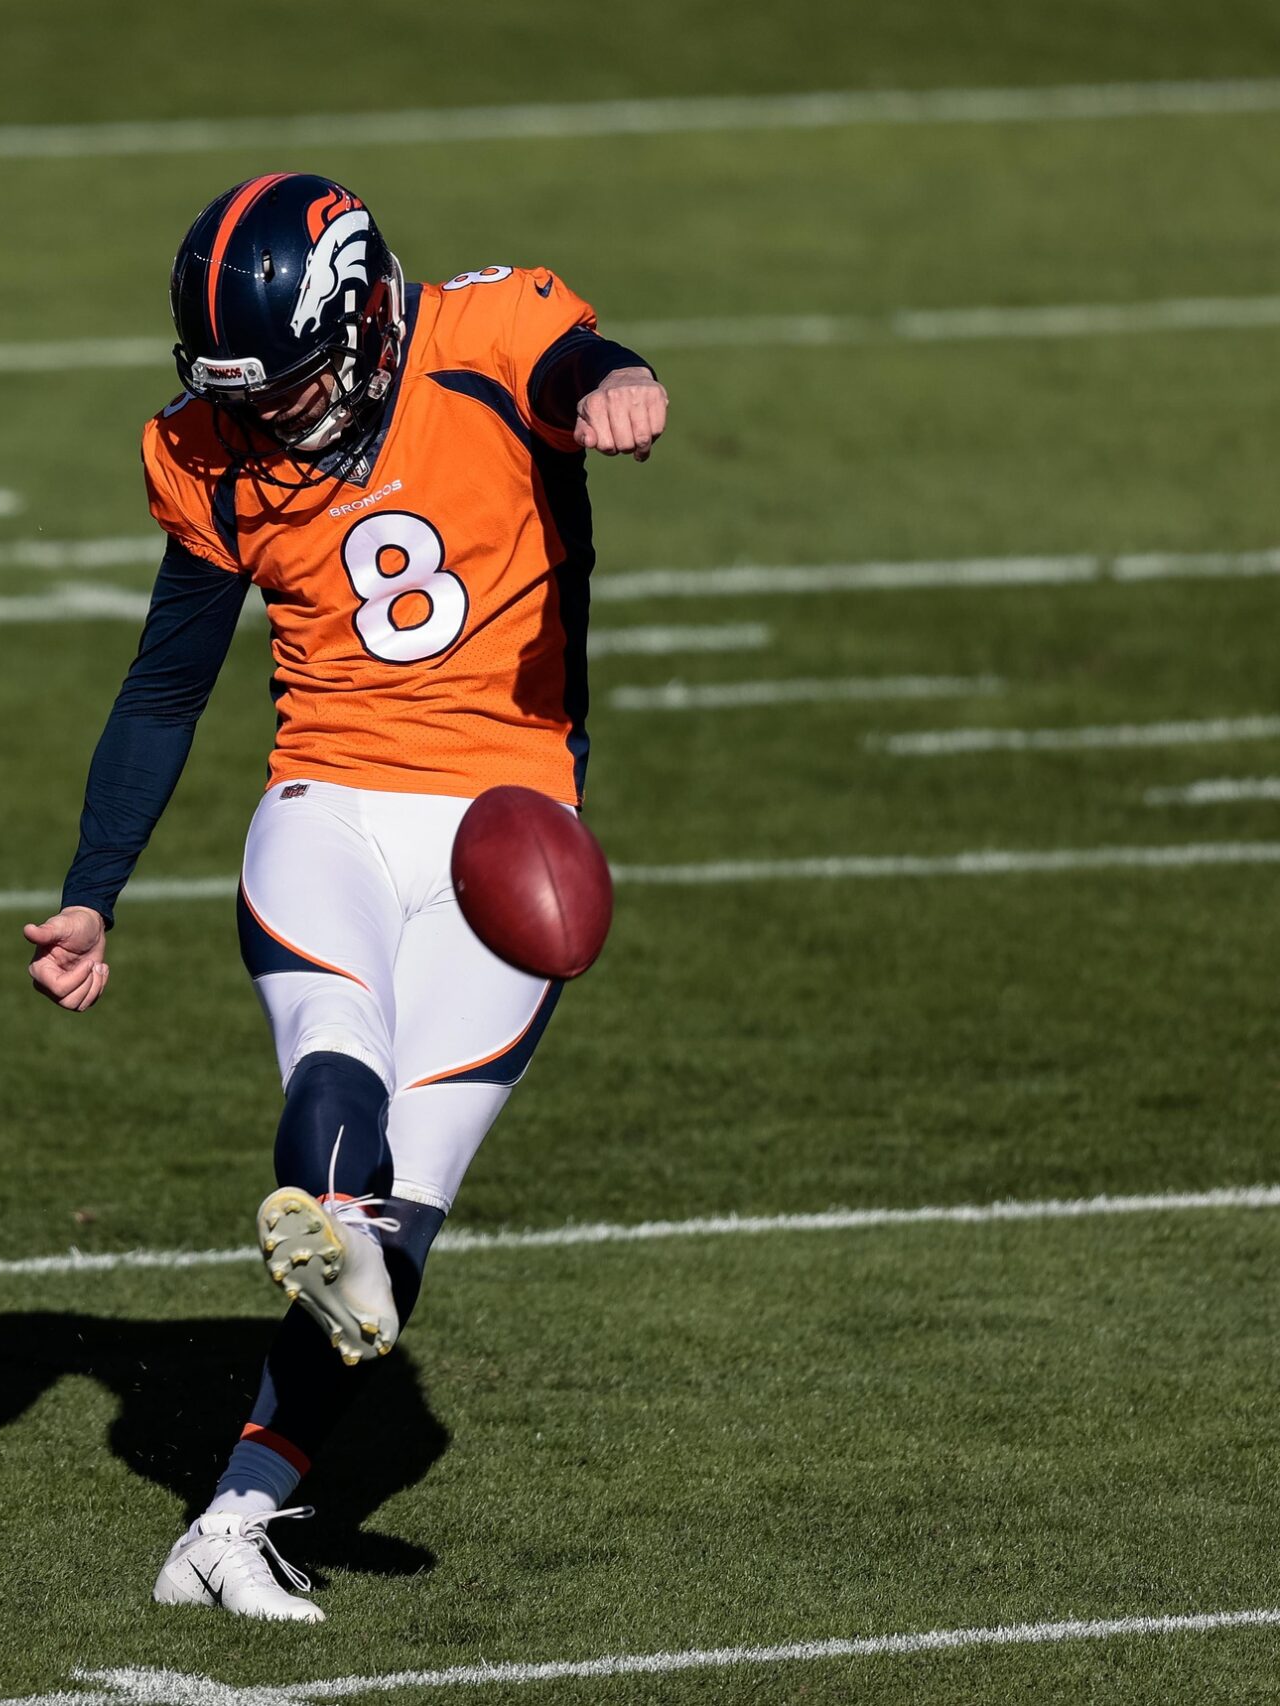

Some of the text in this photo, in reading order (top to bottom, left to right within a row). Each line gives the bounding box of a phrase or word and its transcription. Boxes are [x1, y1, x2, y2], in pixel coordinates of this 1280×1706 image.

[442, 265, 513, 291] 8
[330, 479, 402, 517] BRONCOS
[340, 510, 469, 666] 8
